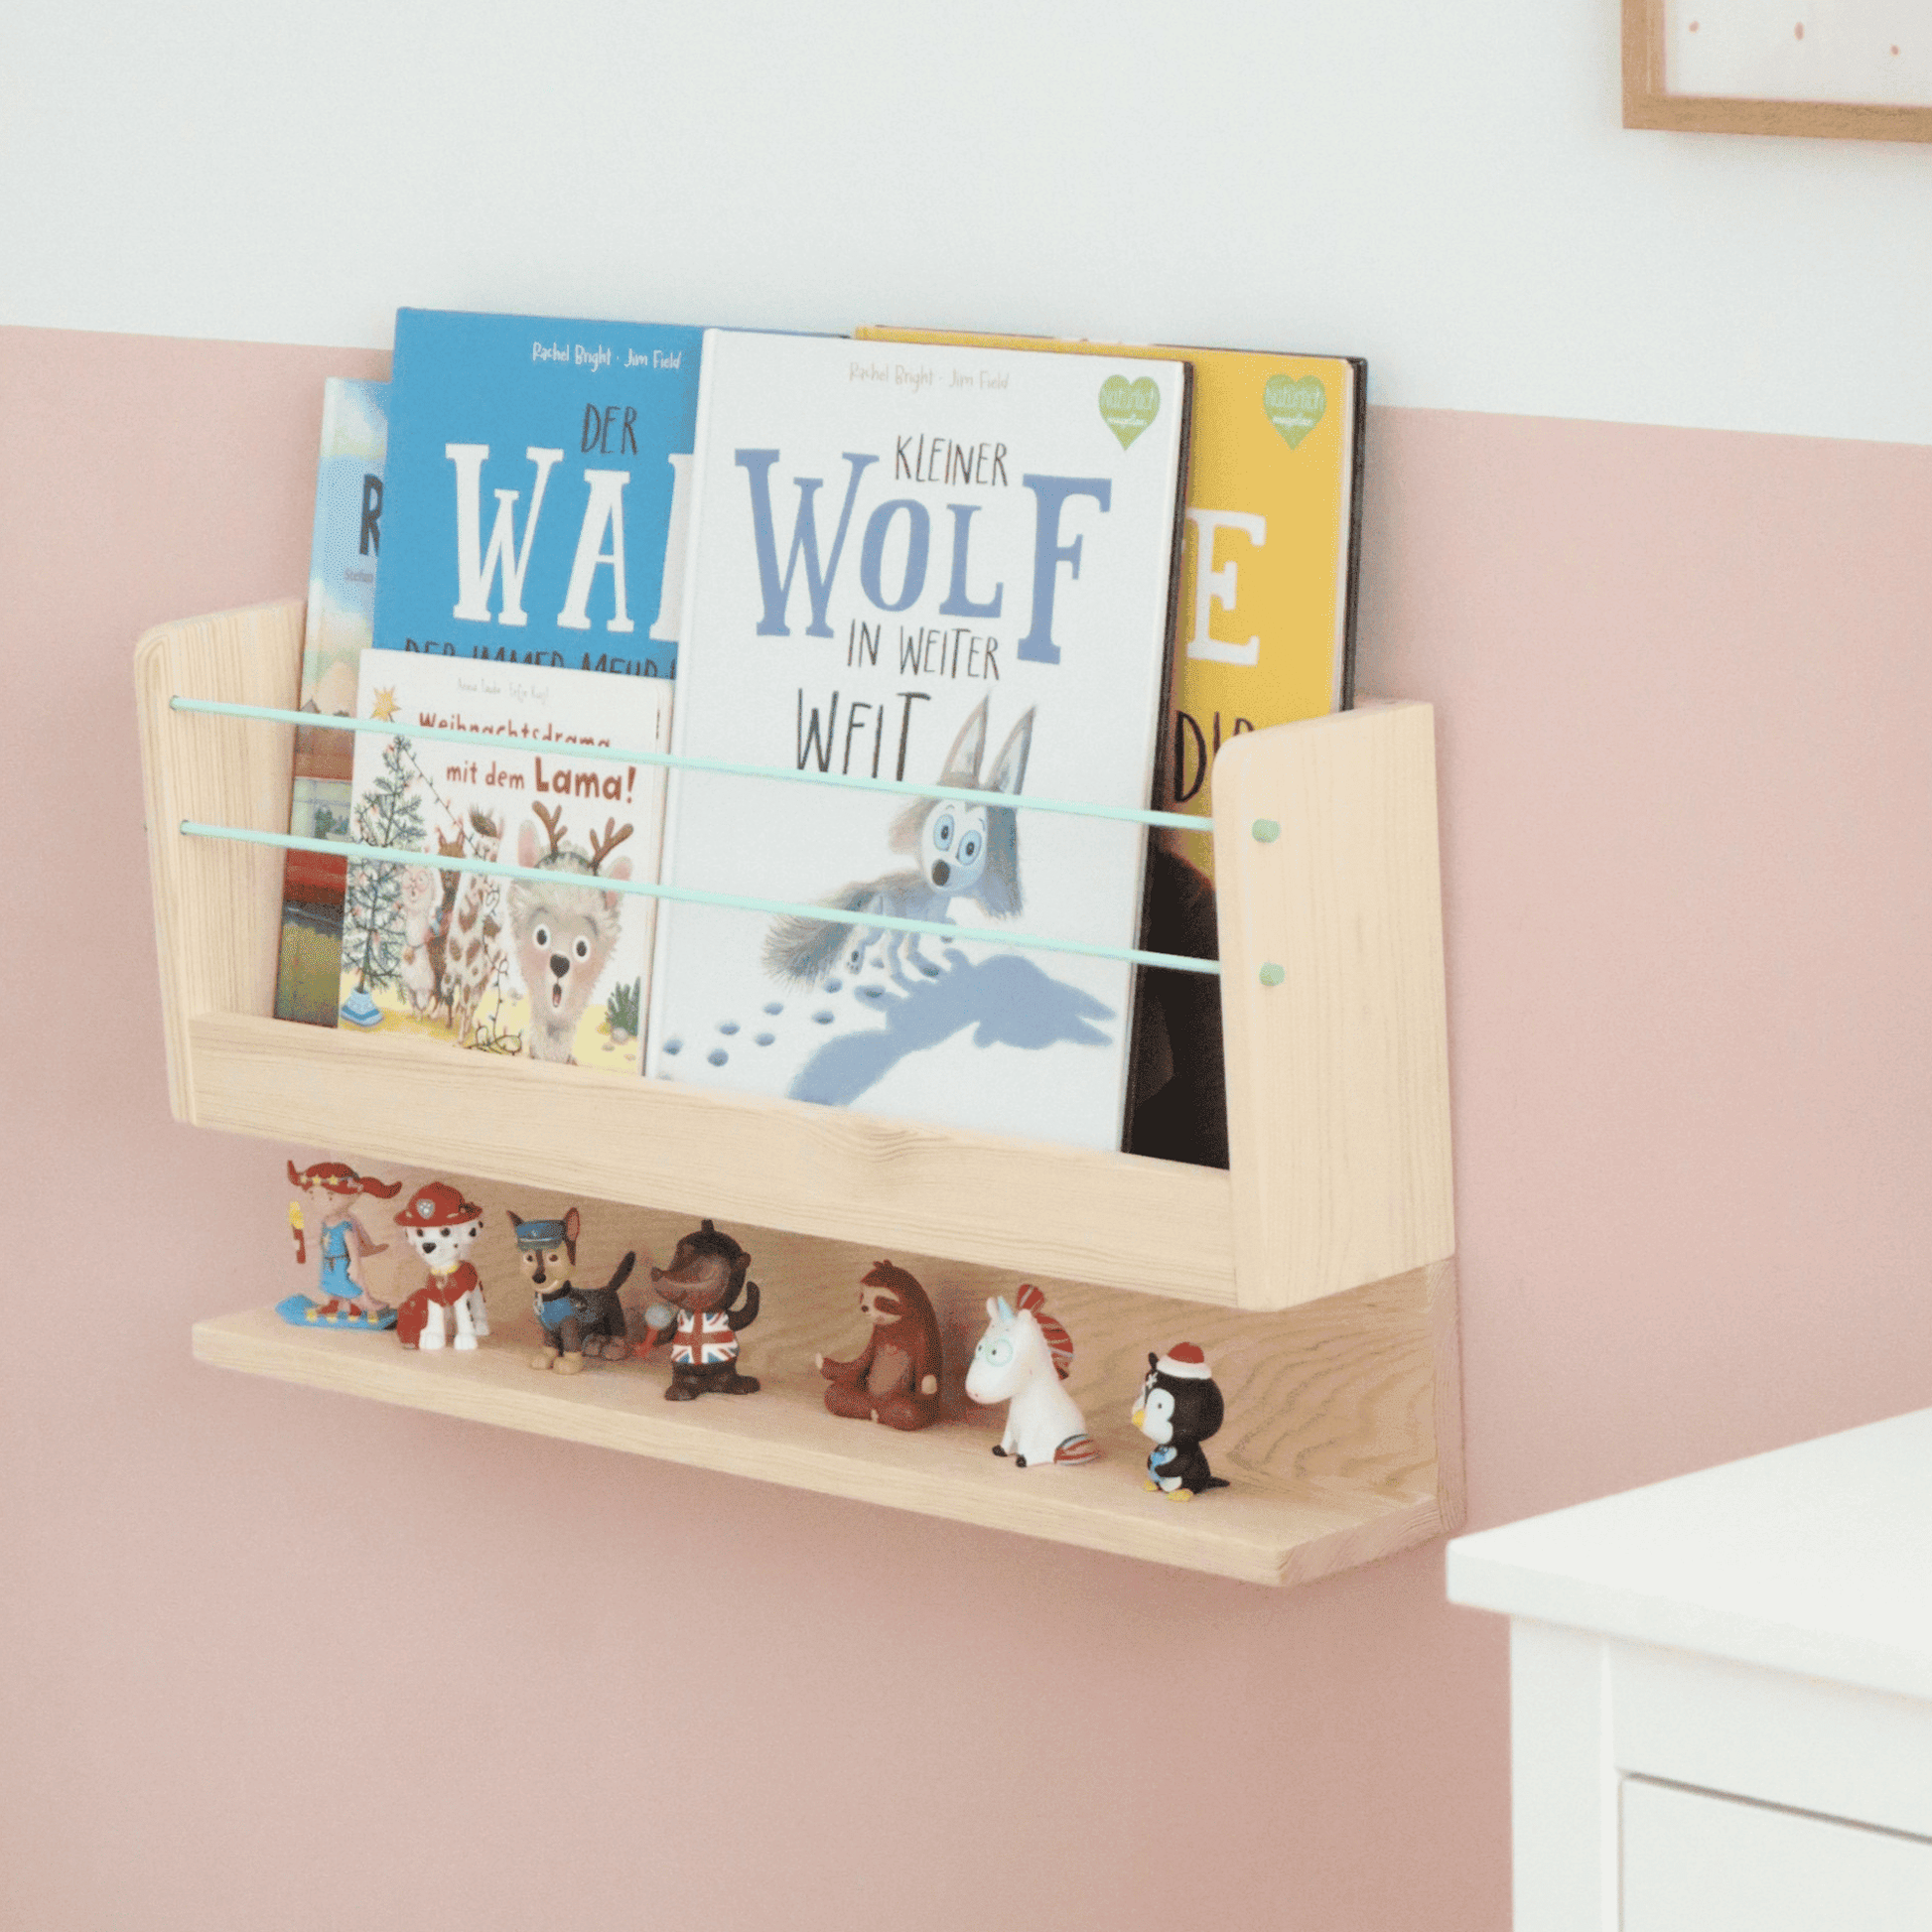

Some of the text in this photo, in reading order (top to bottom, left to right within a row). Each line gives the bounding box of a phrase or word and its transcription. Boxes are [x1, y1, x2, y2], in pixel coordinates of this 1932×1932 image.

[532, 341, 682, 372] Rachel Bright Jim Field
[849, 361, 1011, 394] Rachel Bright Jim Field
[581, 403, 638, 456] DER
[895, 434, 1009, 486] KLEINER
[735, 448, 1113, 665] WOLF
[847, 619, 1000, 680] IN WEITER
[796, 687, 931, 782] WEIT
[446, 756, 637, 804] mit dem Lama!
